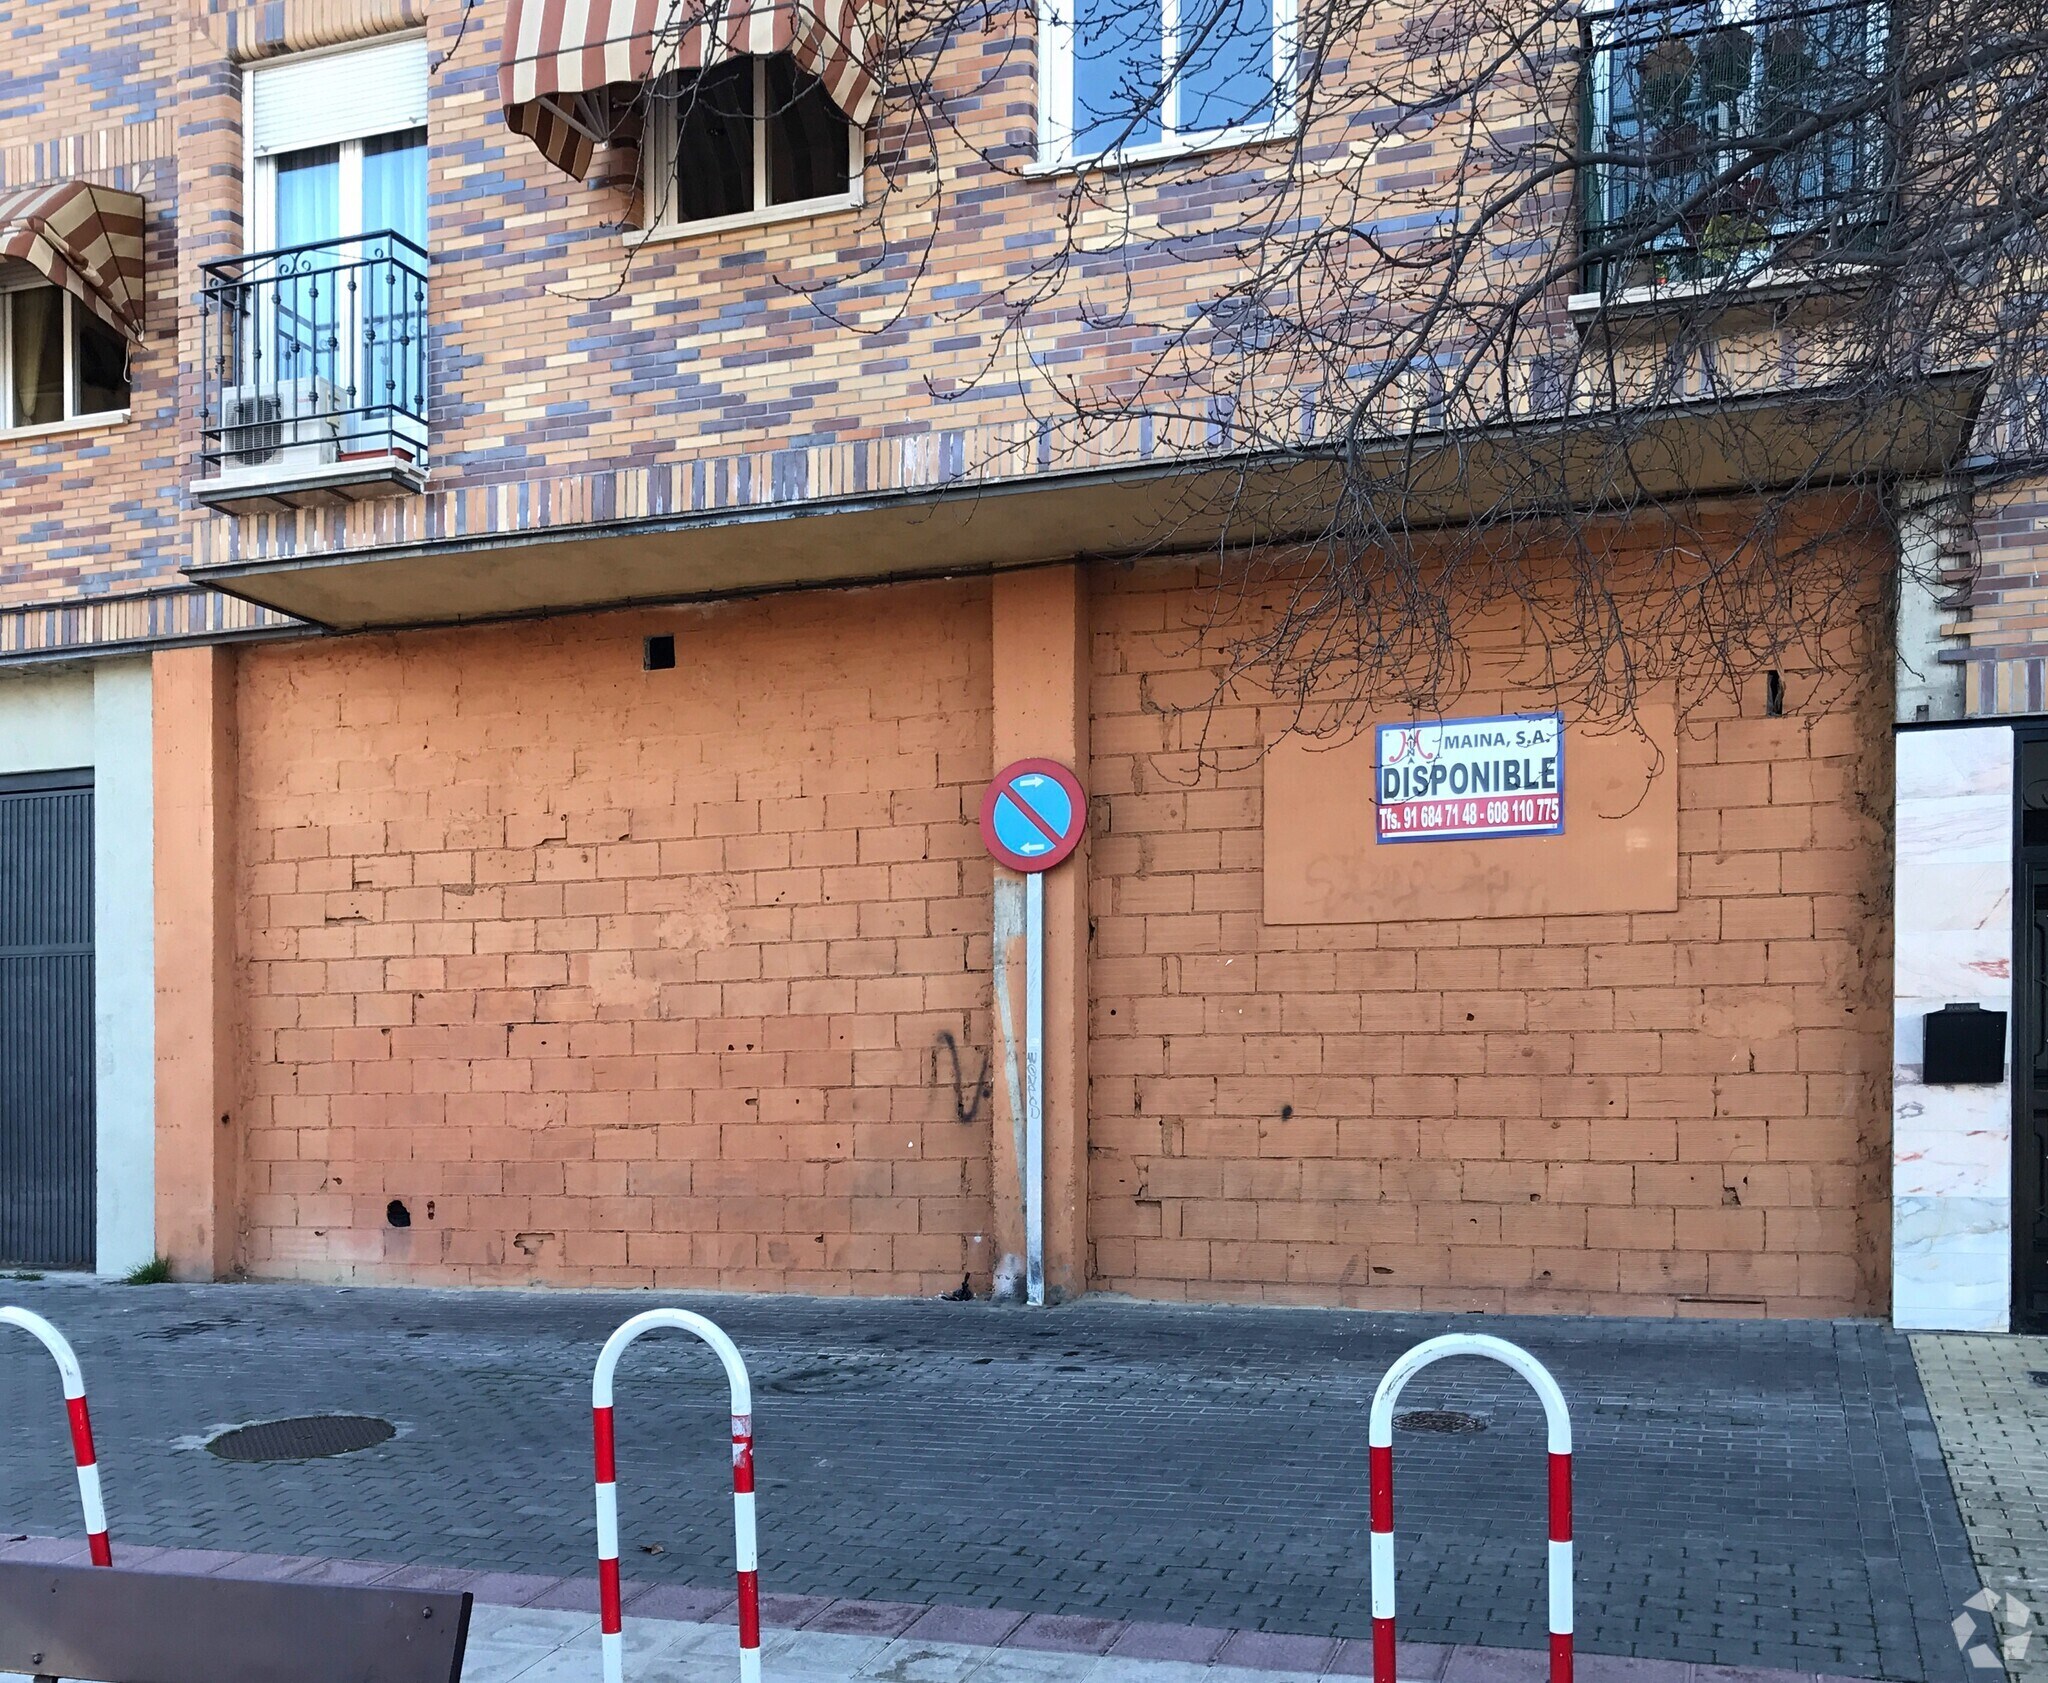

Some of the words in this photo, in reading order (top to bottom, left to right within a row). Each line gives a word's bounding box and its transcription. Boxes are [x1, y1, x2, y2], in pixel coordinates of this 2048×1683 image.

[1444, 732, 1511, 750] MAINA,
[1383, 757, 1556, 799] DISPONIBLE
[1379, 808, 1401, 830] Tfs.
[1403, 806, 1417, 828] 91
[1421, 804, 1442, 827] 684
[1445, 803, 1458, 826] 71
[1462, 802, 1477, 825] 48
[1487, 800, 1509, 824] 608
[1512, 799, 1534, 823] 110
[1537, 797, 1559, 821] 775
